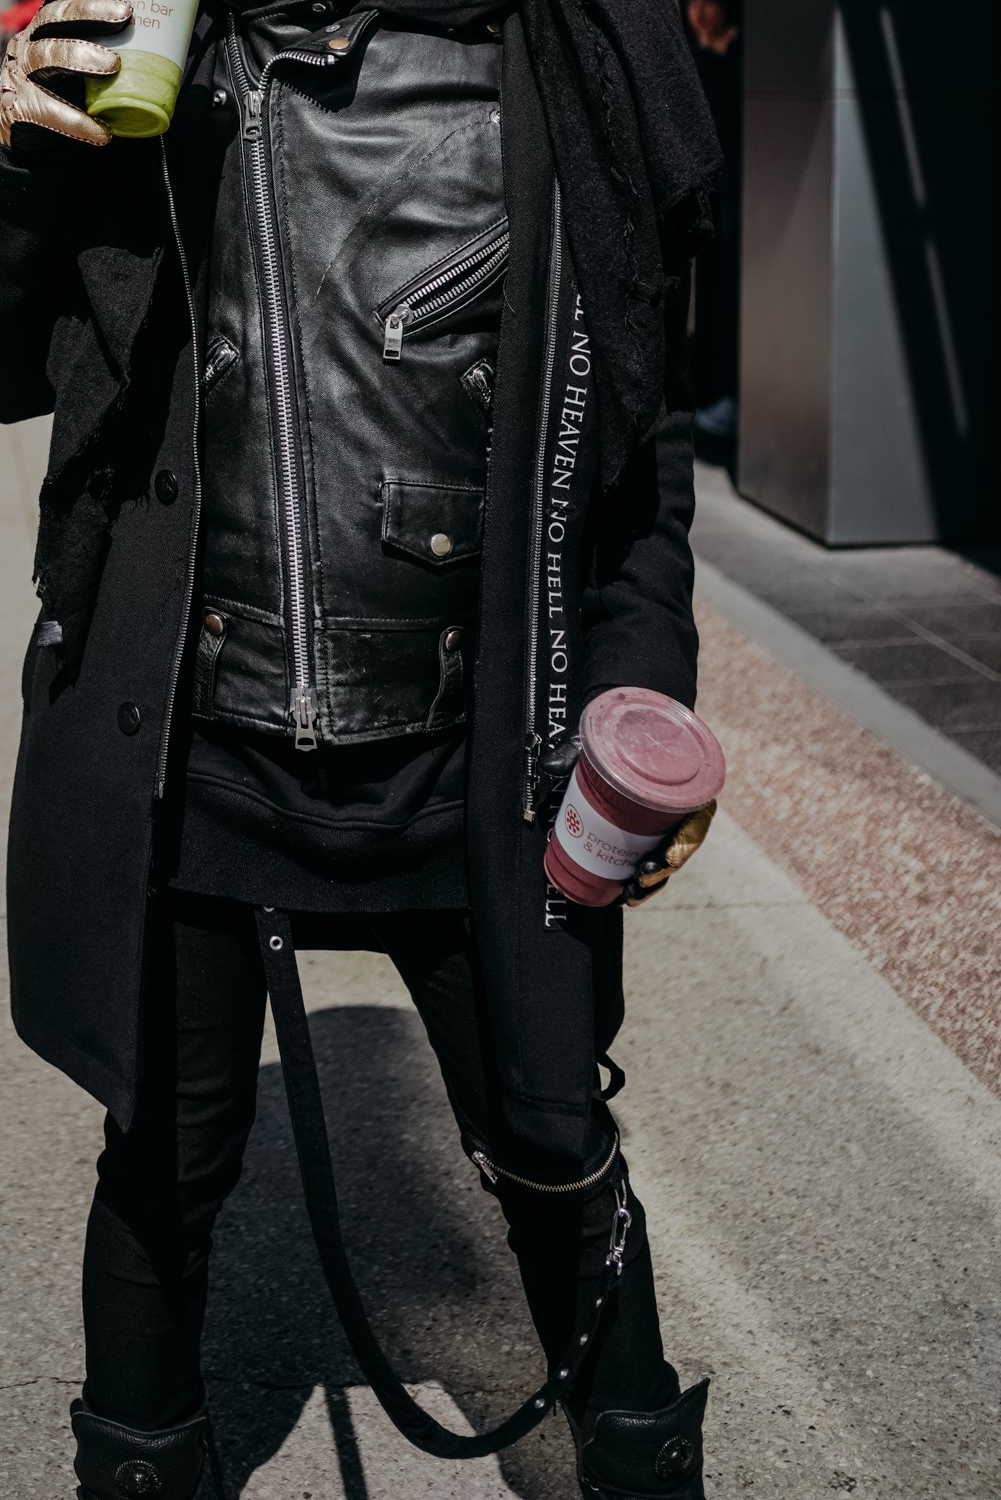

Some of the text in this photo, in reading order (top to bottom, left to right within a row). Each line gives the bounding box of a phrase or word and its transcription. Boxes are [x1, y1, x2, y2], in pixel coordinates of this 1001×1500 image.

[150, 0, 174, 17] bar
[569, 330, 592, 376] NO
[551, 383, 588, 490] HEAVEN
[547, 497, 569, 543] NO
[547, 552, 564, 618] HELL
[550, 629, 568, 673] NO
[583, 841, 634, 867] & kitch
[587, 832, 639, 858] protein
